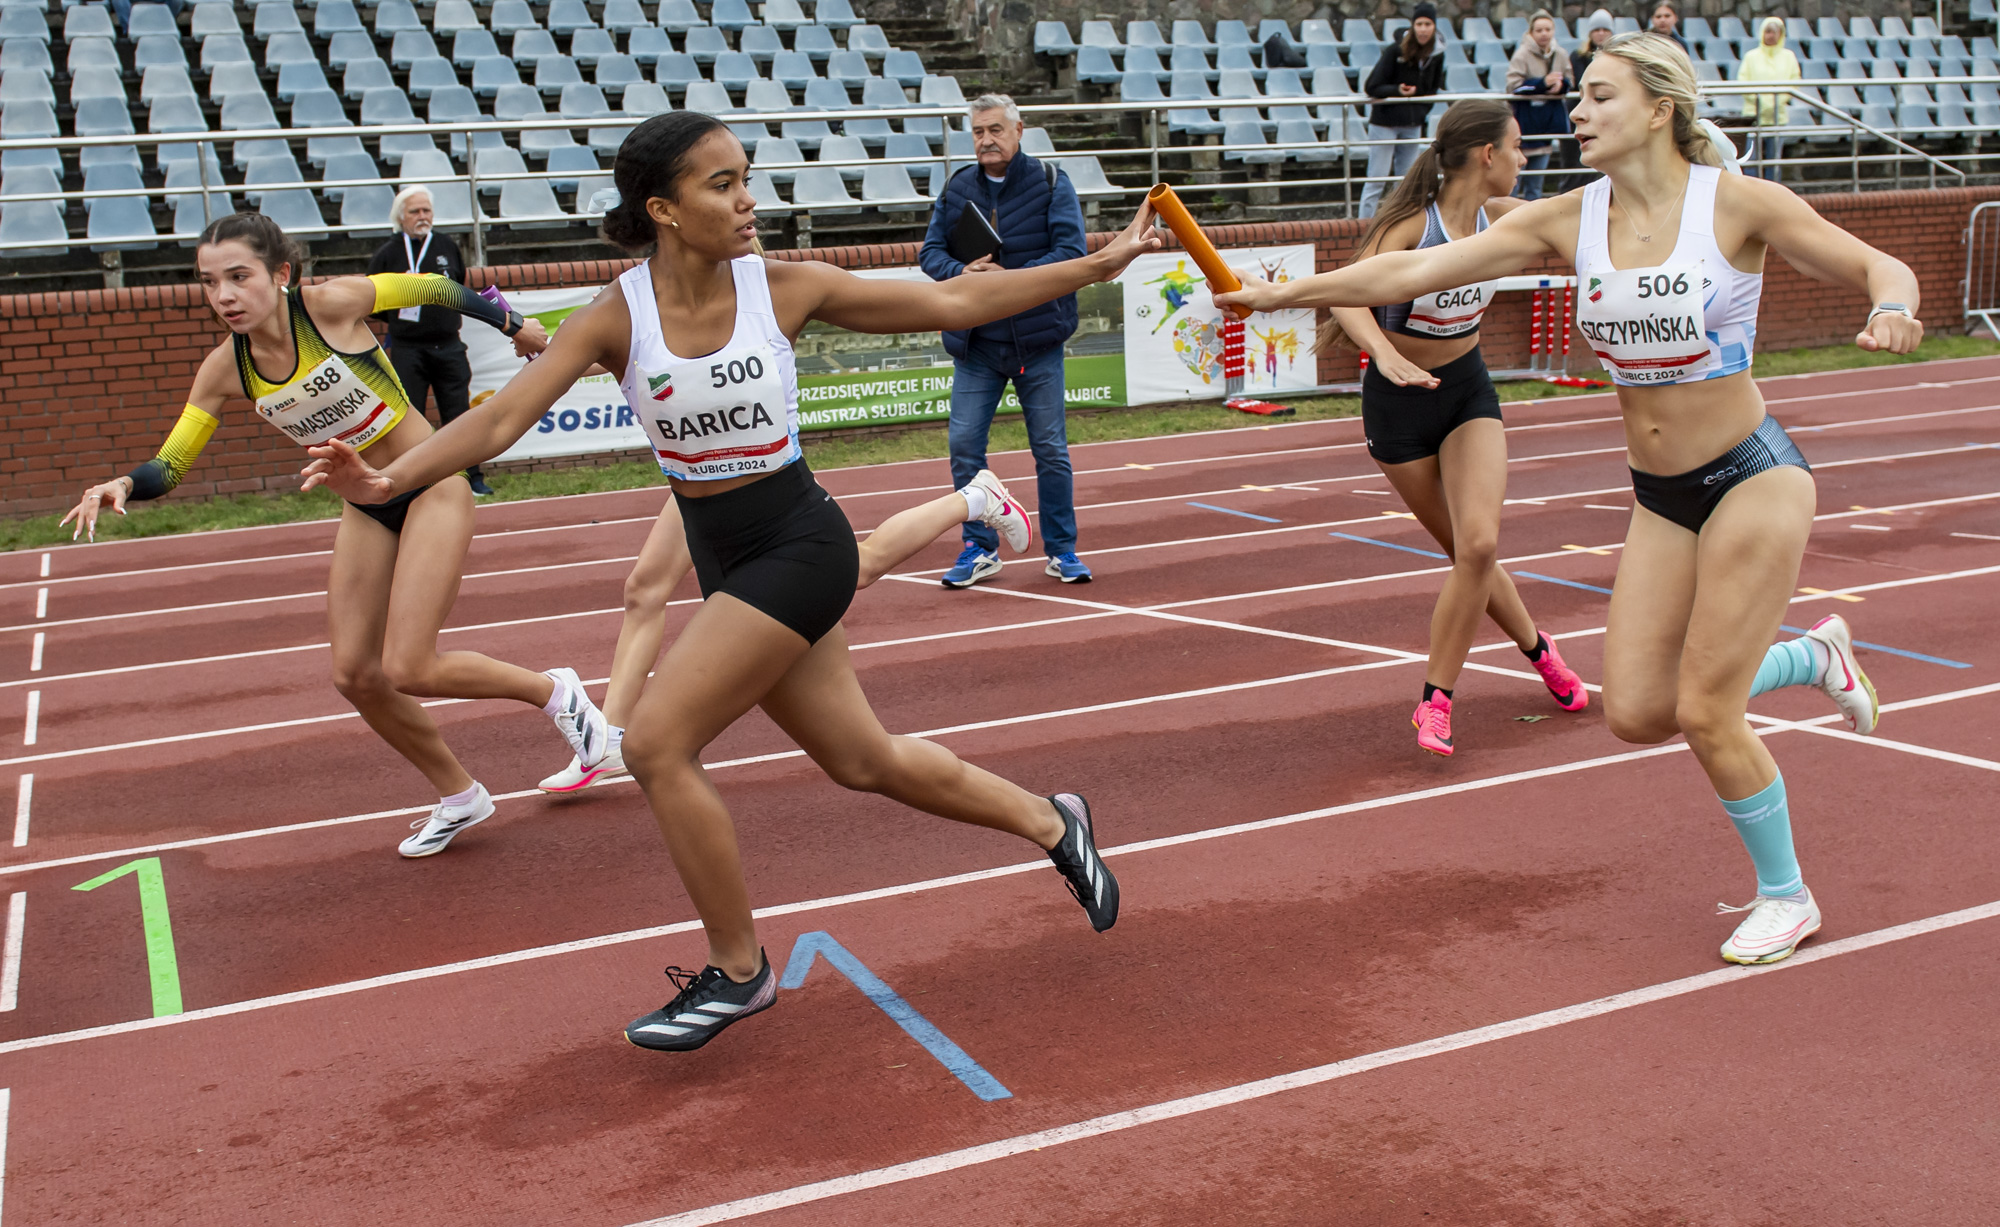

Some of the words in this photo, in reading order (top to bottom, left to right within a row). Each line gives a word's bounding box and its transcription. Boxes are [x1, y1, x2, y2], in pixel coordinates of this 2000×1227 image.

[1435, 287, 1482, 309] GACA
[1637, 273, 1689, 298] 506
[1427, 324, 1458, 334] SŁUBICE
[1458, 321, 1474, 331] 2024
[1581, 313, 1699, 345] SZCZYPIŃSKA
[302, 367, 342, 398] 588
[710, 355, 764, 389] 500
[1654, 369, 1684, 380] 2024
[1065, 386, 1112, 402] ŁUBICE
[281, 387, 370, 439] TOMASZEWSKA
[537, 404, 634, 434] SOSiR
[655, 402, 774, 442] BARICA
[797, 406, 868, 425] RMISTRZA
[871, 401, 922, 419] SŁUBIC
[924, 400, 934, 414] Z
[356, 426, 377, 443] 2024
[687, 462, 735, 475] SŁUBICE
[737, 460, 767, 471] 2024
